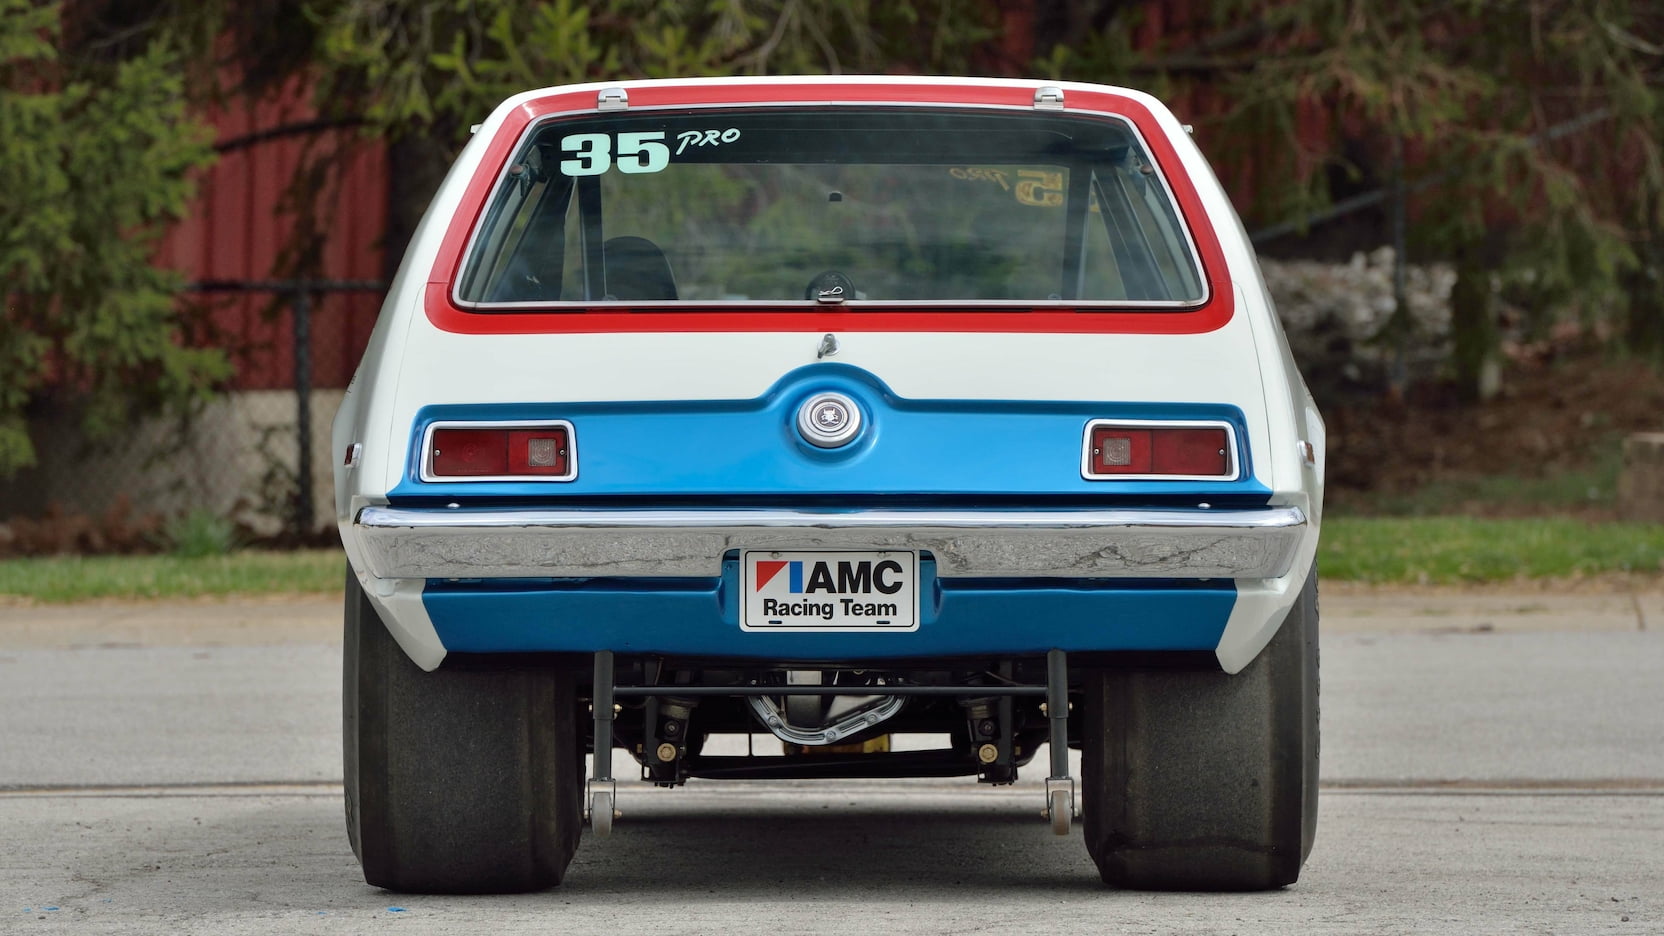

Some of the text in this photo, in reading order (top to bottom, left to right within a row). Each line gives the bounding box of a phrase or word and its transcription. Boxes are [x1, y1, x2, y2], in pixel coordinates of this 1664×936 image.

[560, 128, 741, 176] 35 PRO
[805, 560, 904, 595] AMC
[763, 598, 897, 620] Racing Team
